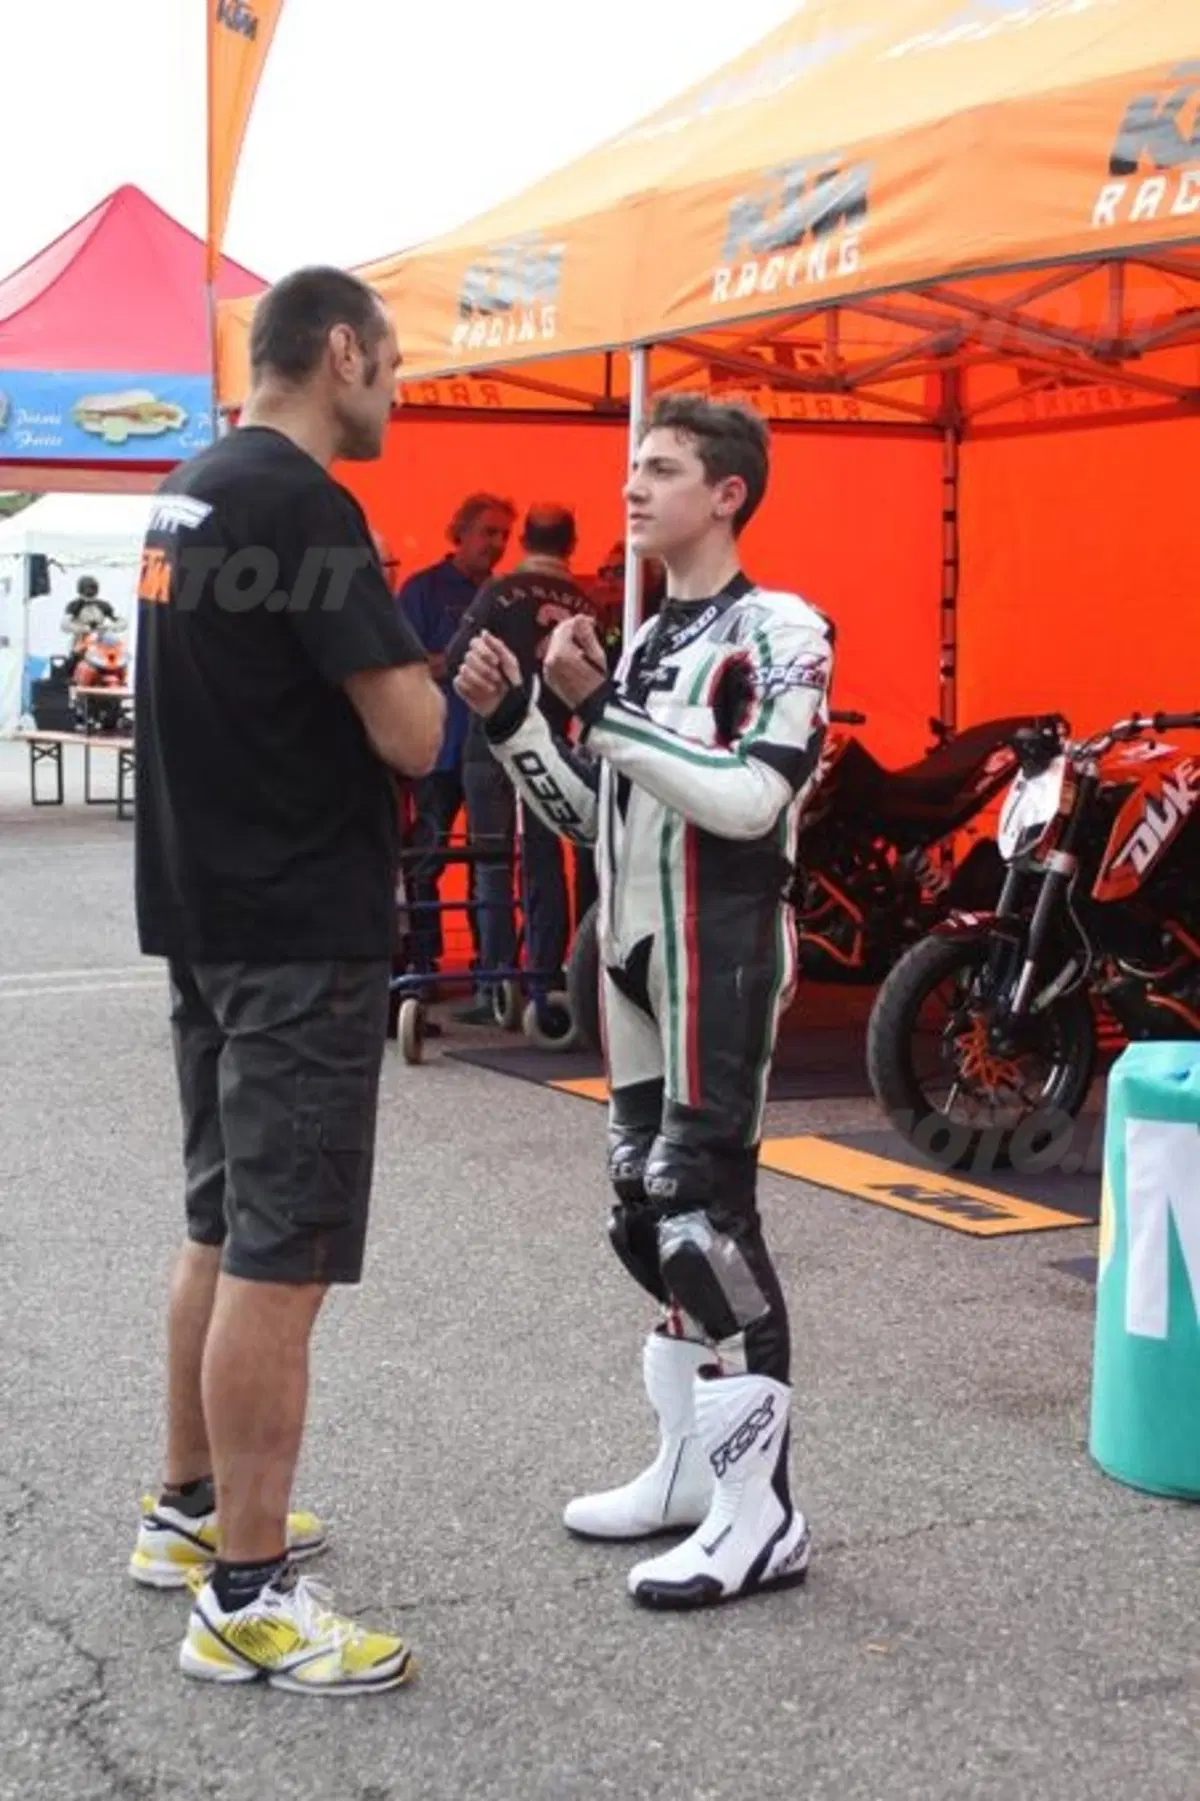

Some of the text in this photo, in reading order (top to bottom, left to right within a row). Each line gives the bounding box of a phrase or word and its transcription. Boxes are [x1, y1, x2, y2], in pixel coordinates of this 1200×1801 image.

[1091, 170, 1200, 230] RAC
[711, 235, 862, 304] RACING
[1111, 757, 1200, 875] DUKE
